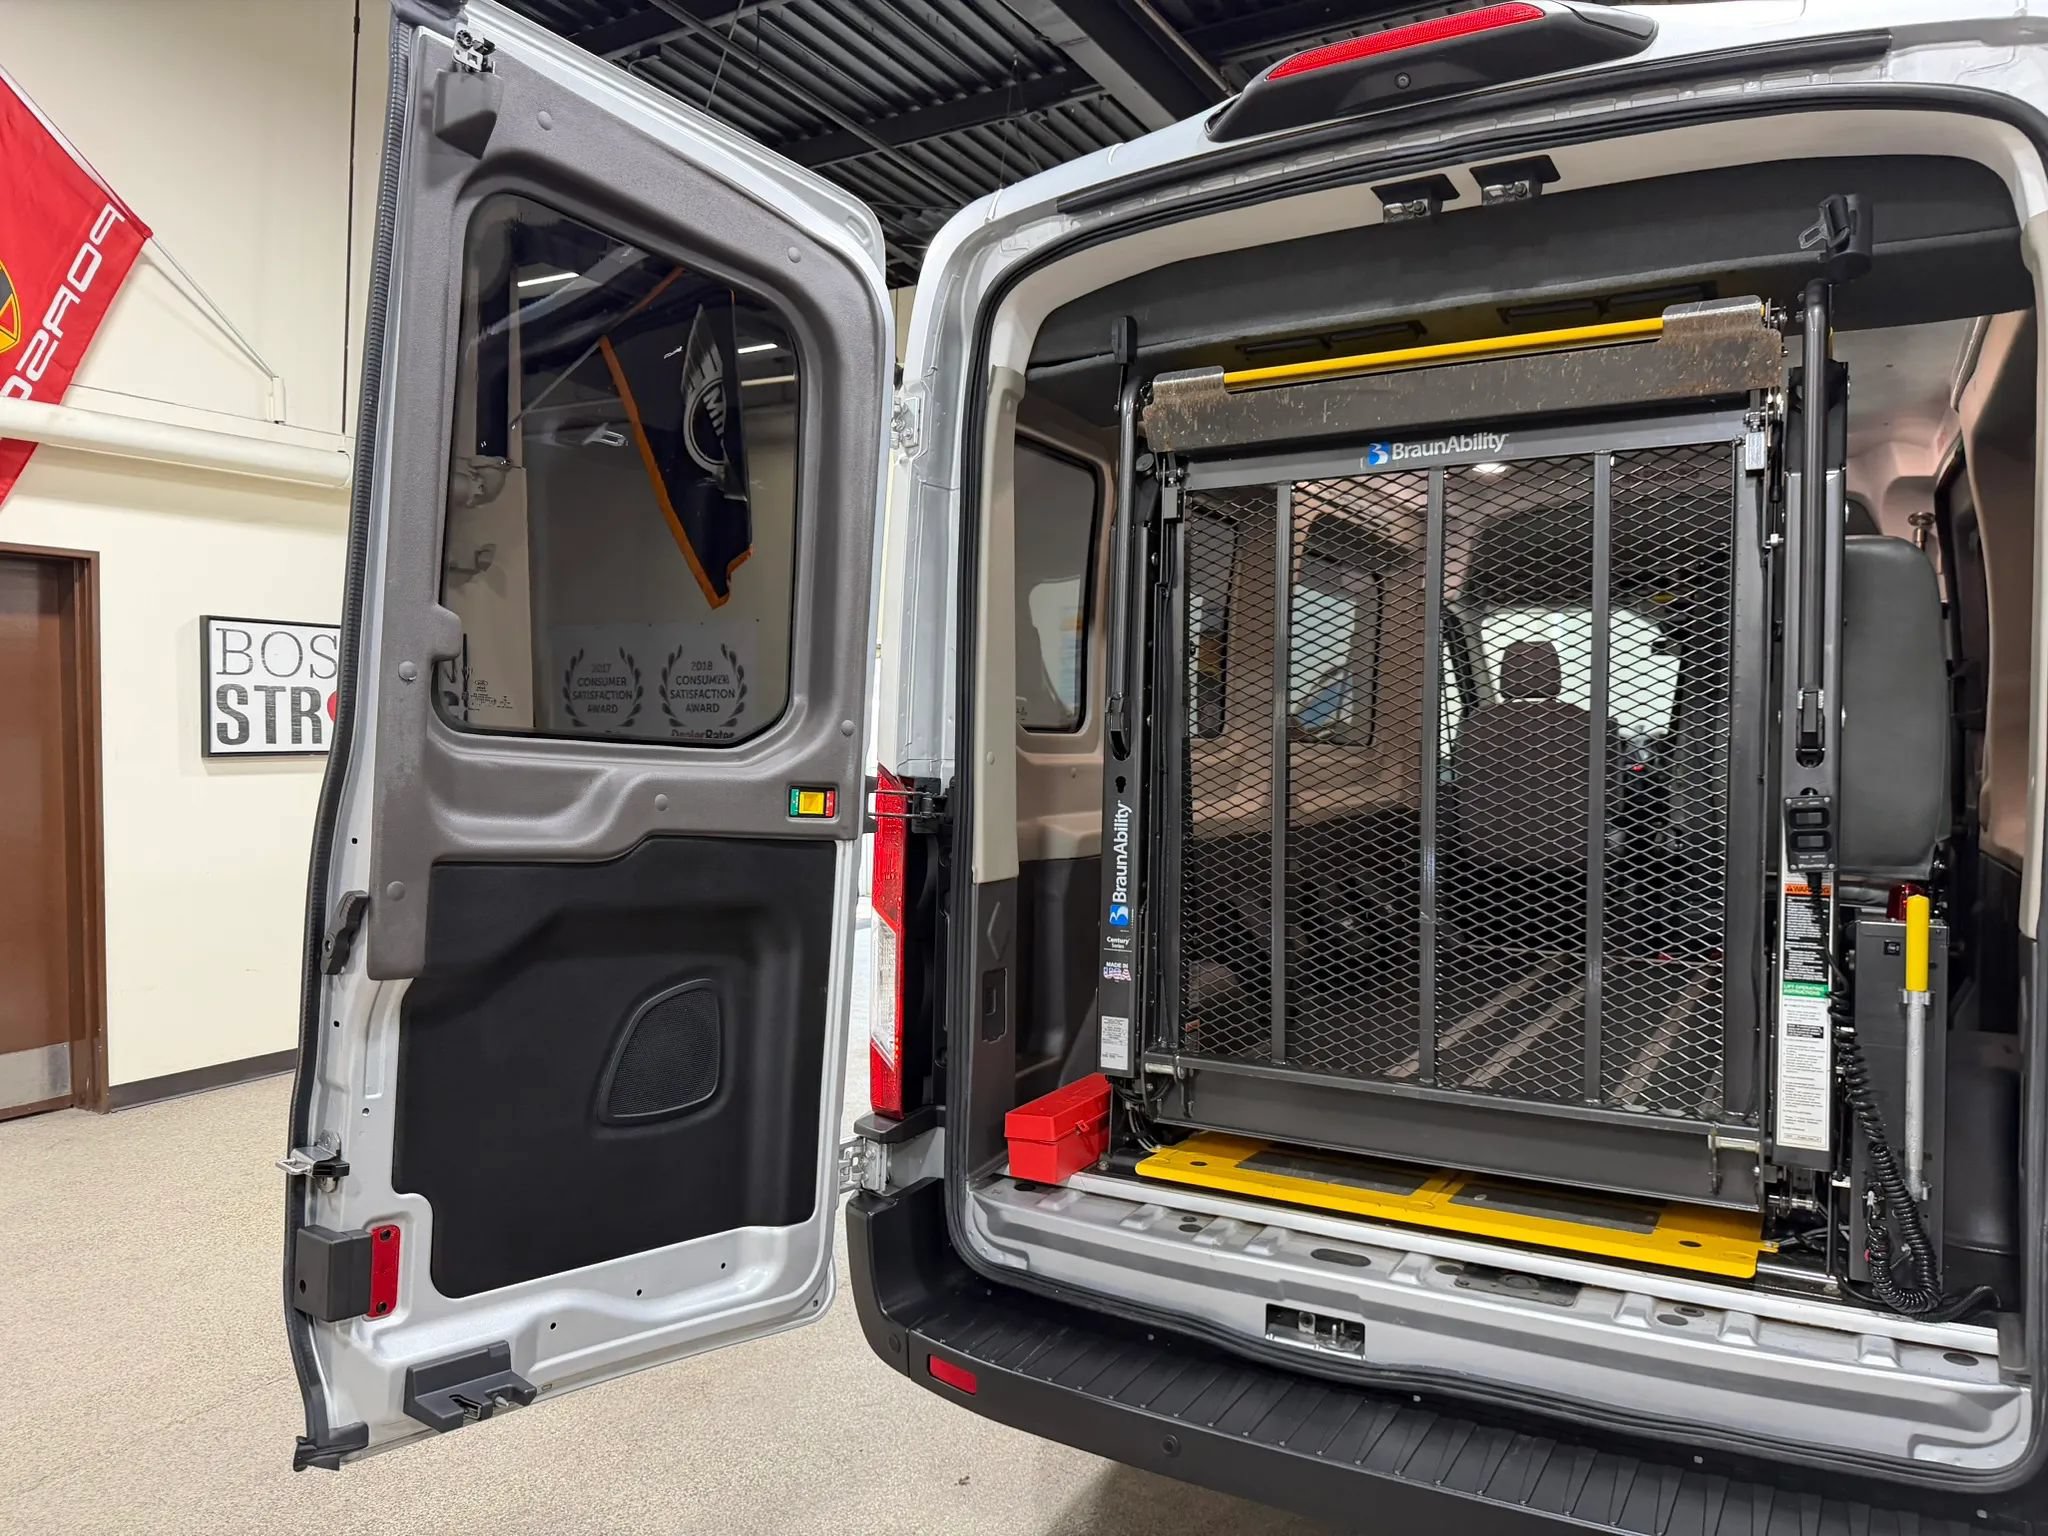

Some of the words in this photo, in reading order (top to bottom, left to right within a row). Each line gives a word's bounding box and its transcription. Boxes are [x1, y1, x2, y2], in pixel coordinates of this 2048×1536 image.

[1391, 433, 1507, 460] BraunAbility
[215, 627, 338, 680] BOS
[690, 660, 713, 671] 2018
[577, 676, 627, 687] CONSUMER
[675, 674, 730, 686] CONSUMER
[572, 689, 633, 700] SATISFACTION
[670, 688, 736, 699] SATISFACTION
[587, 703, 618, 714] AWARD
[685, 702, 720, 713] AWARD
[1112, 802, 1132, 903] BraunAbility
[1106, 936, 1130, 945] Century
[1103, 966, 1132, 981] USA
